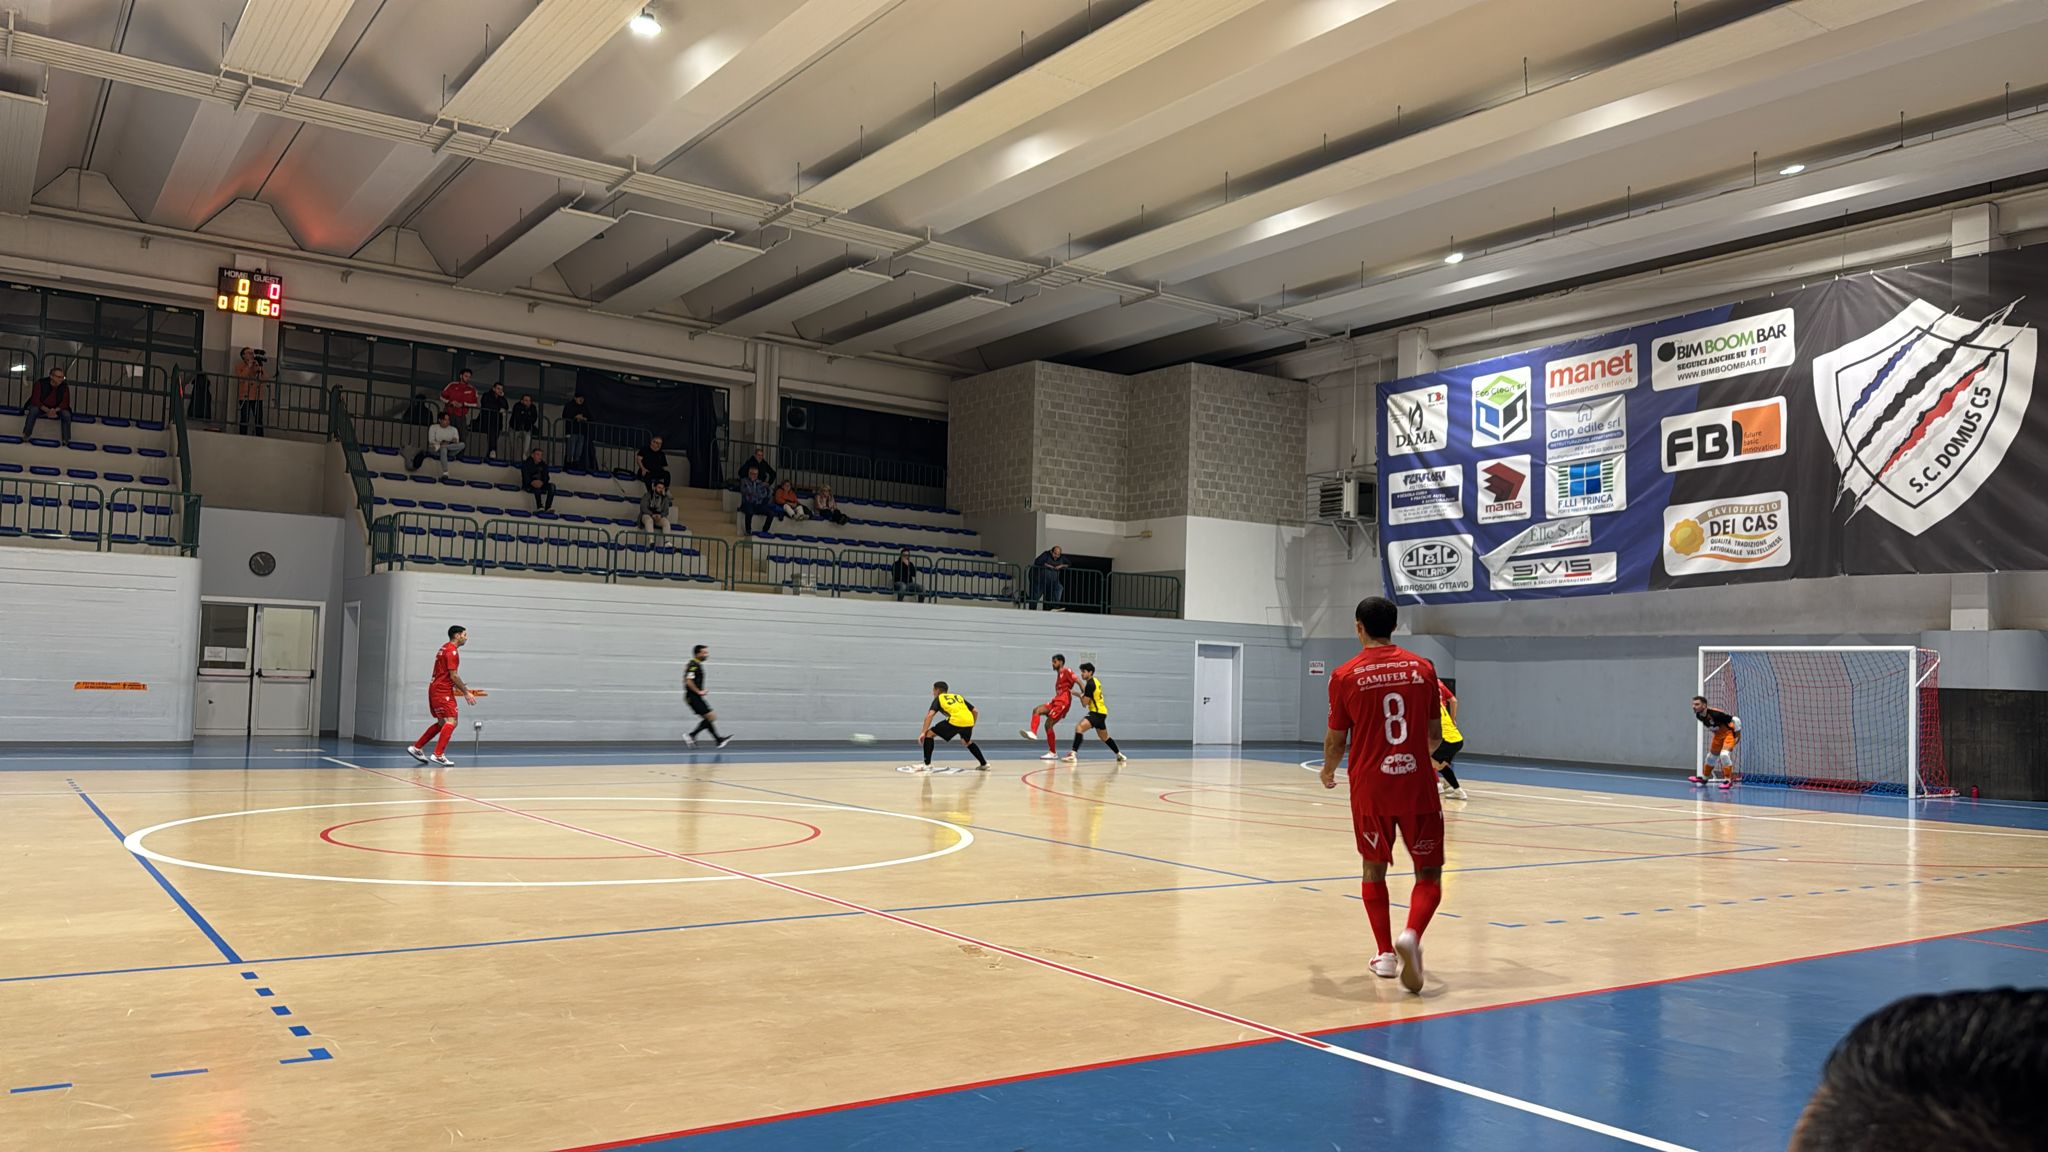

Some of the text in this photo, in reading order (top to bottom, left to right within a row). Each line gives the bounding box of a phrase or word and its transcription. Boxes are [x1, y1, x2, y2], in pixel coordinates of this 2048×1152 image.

[224, 269, 280, 284] HOME GUEST
[238, 279, 250, 295] 0
[270, 283, 280, 300] 0
[218, 295, 228, 310] 0
[233, 295, 249, 312] 18
[271, 303, 280, 317] 0
[1550, 349, 1633, 388] manet
[1677, 350, 1747, 371] SEGUICI ANCHE SU
[1677, 357, 1767, 381] WWW.BIMBOOMBAR.IT
[1475, 381, 1527, 398] Eco Clean srl
[1549, 376, 1633, 399] maintenance network
[1550, 417, 1621, 440] Gmp edile srl
[1396, 430, 1437, 448] DAMA
[1909, 387, 1991, 493] S.C. DOMUS C5
[1743, 443, 1778, 454] innovation
[1485, 501, 1523, 512] mama
[1558, 494, 1613, 508] F.LLI TRINCA
[1707, 502, 1778, 518] RAVIOLIFICIO
[1557, 520, 1589, 536] S.r.l.
[1709, 513, 1778, 537] DEI CAS
[1709, 535, 1783, 556] ARTIGIANALE VALTELLINESE
[1734, 539, 1767, 548] TRADIZIONE
[1416, 567, 1448, 577] MILANO
[1512, 558, 1592, 576] SIVIS
[1438, 581, 1469, 590] OTTAVIO
[1356, 672, 1408, 686] GAMIFER
[1383, 692, 1408, 745] 8
